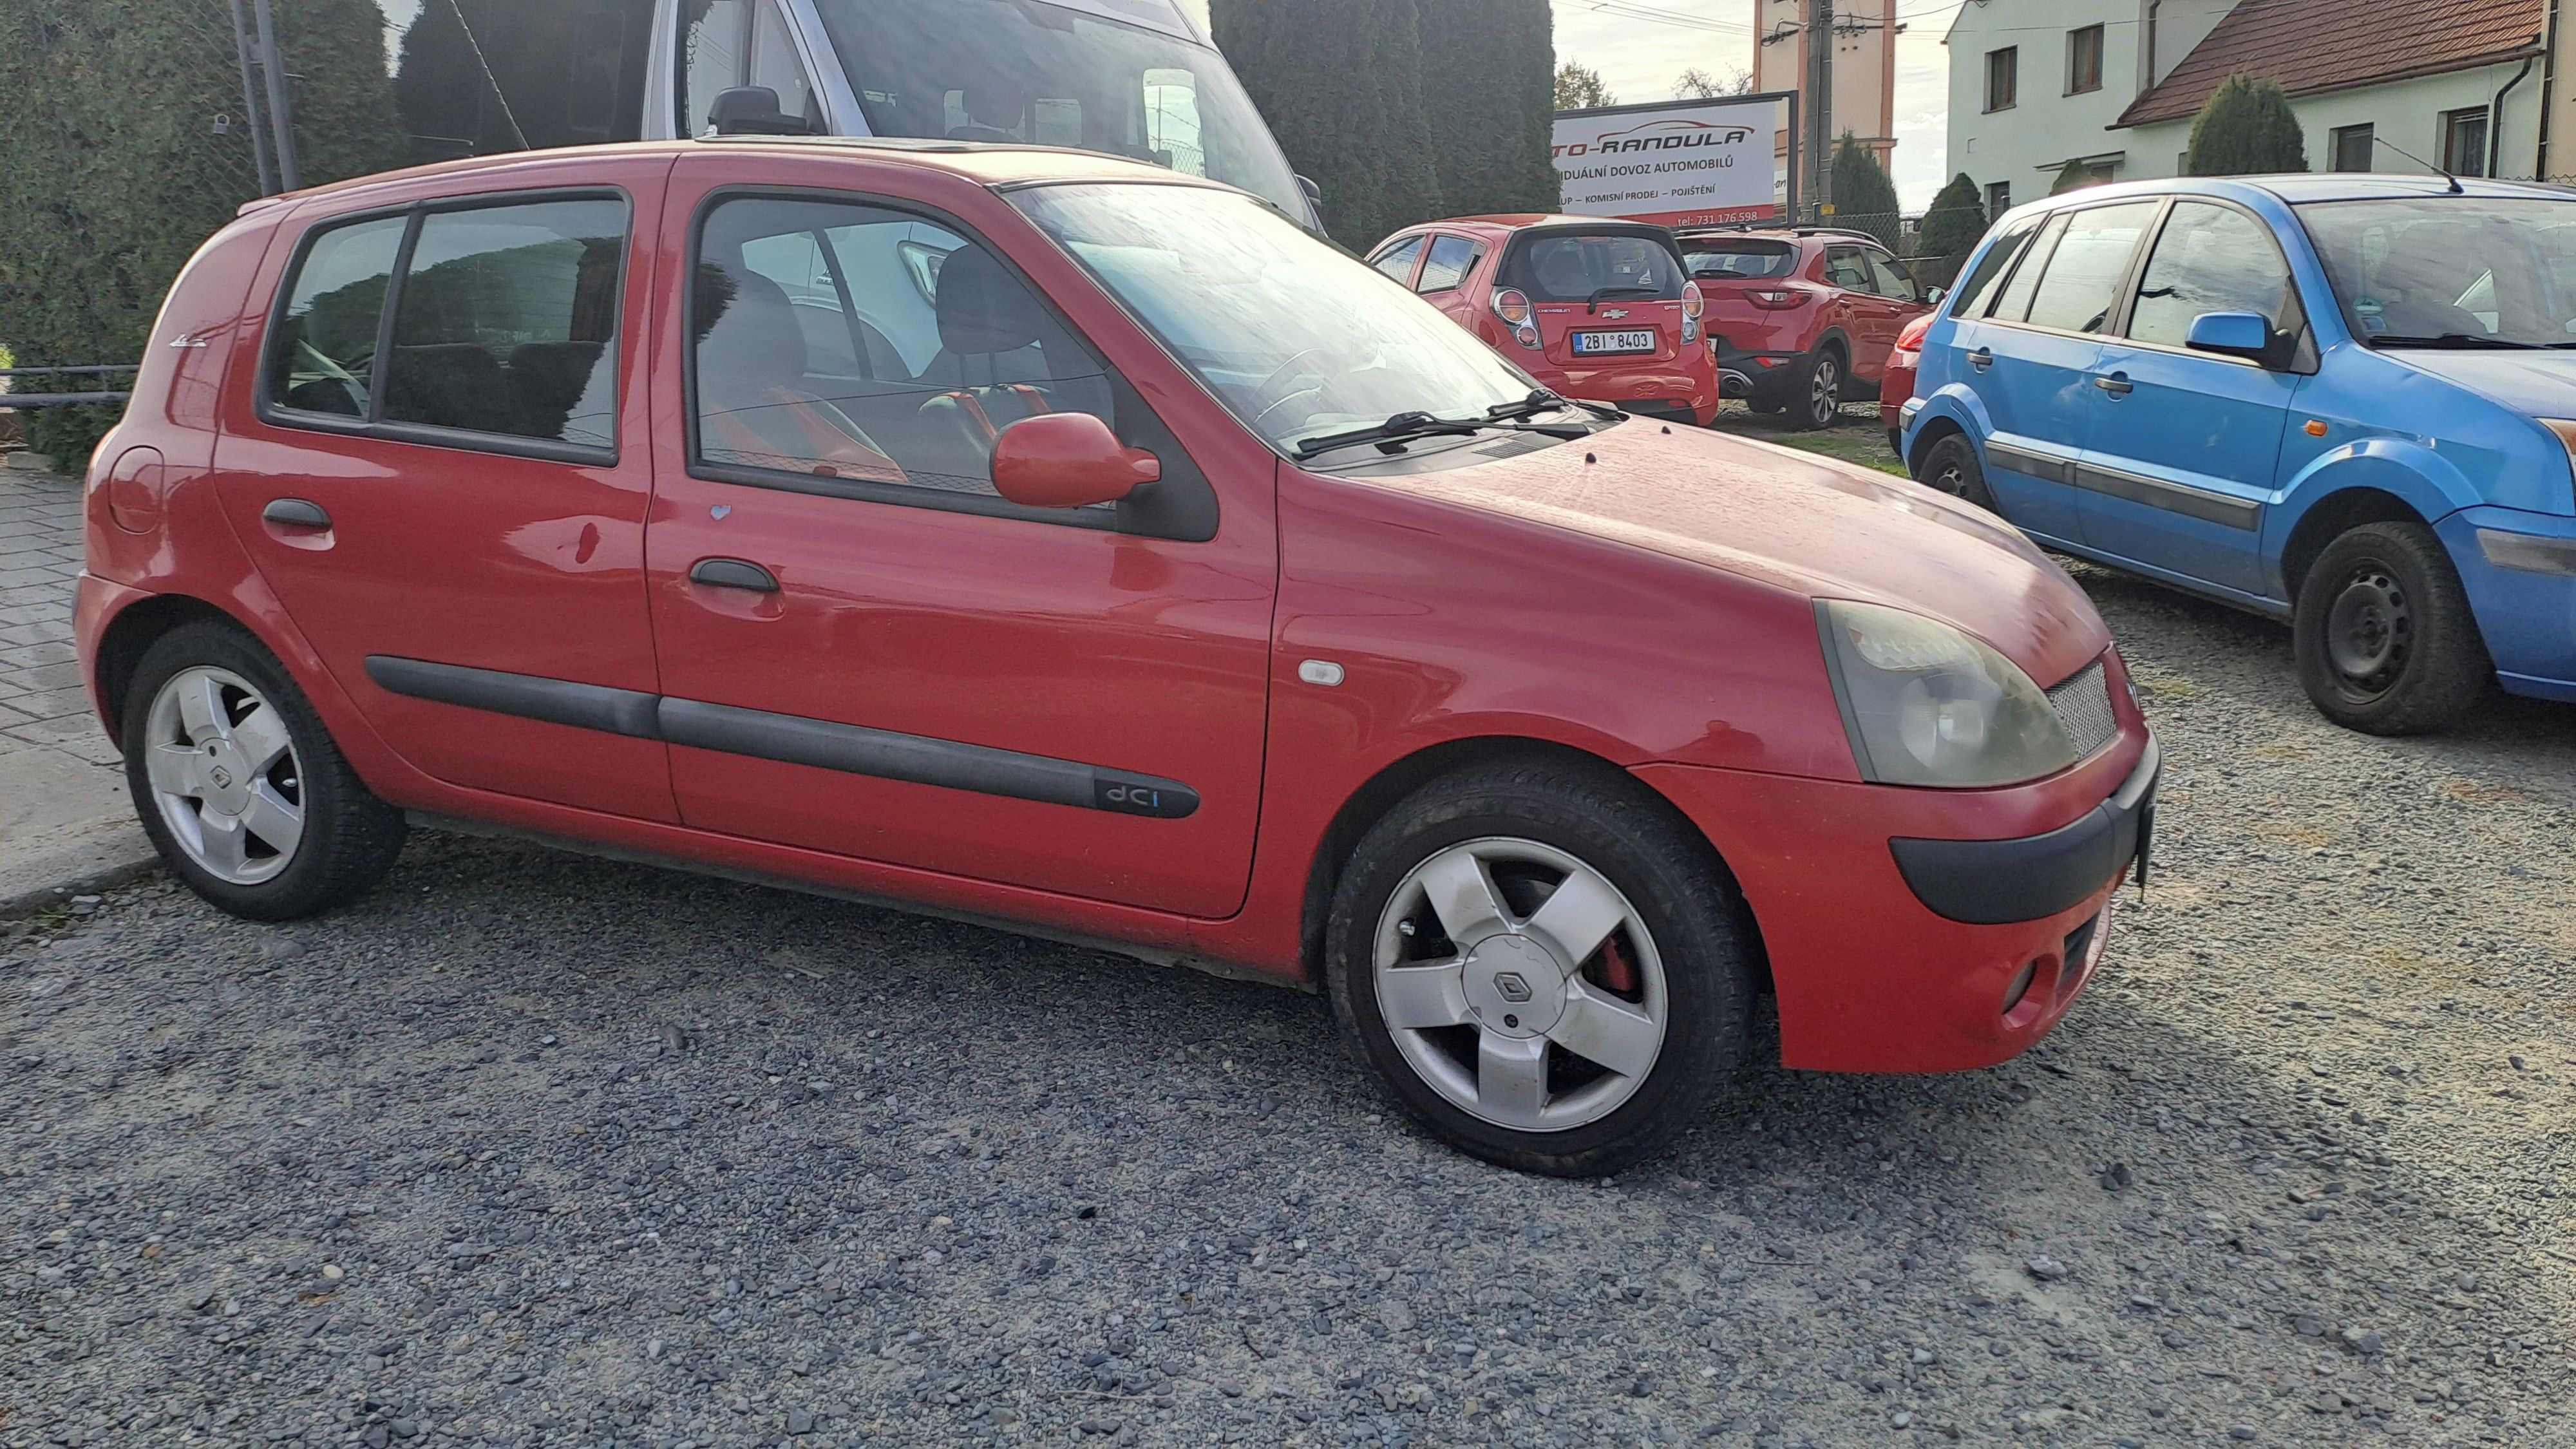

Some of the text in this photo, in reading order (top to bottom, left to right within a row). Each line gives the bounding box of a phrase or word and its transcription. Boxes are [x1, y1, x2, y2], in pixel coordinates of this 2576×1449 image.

[1551, 131, 1745, 158] TO-RANDULA
[1560, 154, 1734, 181] IDUÁLNÍ DOVOZ AUTOMOBILŮ
[1585, 191, 1624, 204] KOMISNÍ
[1626, 191, 1659, 200] PRODEJ
[1671, 183, 1716, 196] POJIŠTĚNÍ
[1678, 211, 1757, 227] tel: 731 176 598
[1618, 334, 1648, 348] 8403
